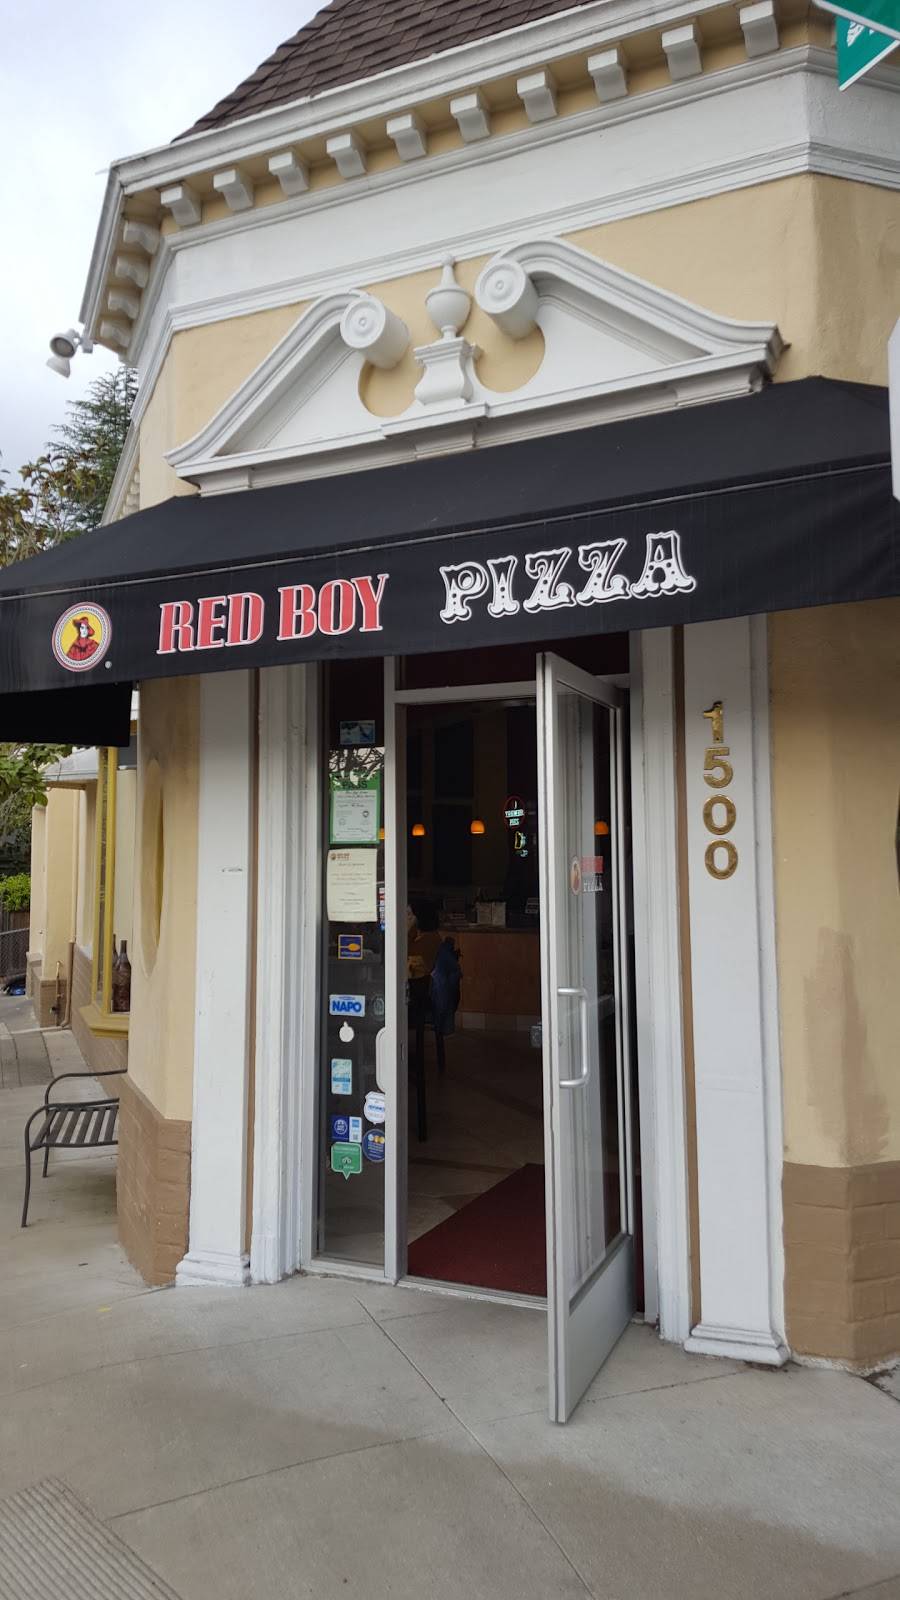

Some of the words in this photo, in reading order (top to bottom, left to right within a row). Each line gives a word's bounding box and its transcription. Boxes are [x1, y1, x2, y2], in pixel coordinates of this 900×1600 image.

[156, 591, 265, 655] RED
[276, 572, 390, 642] BOY
[438, 529, 698, 625] PIZZA
[702, 701, 739, 881] 1500
[332, 1000, 362, 1013] NAPO
